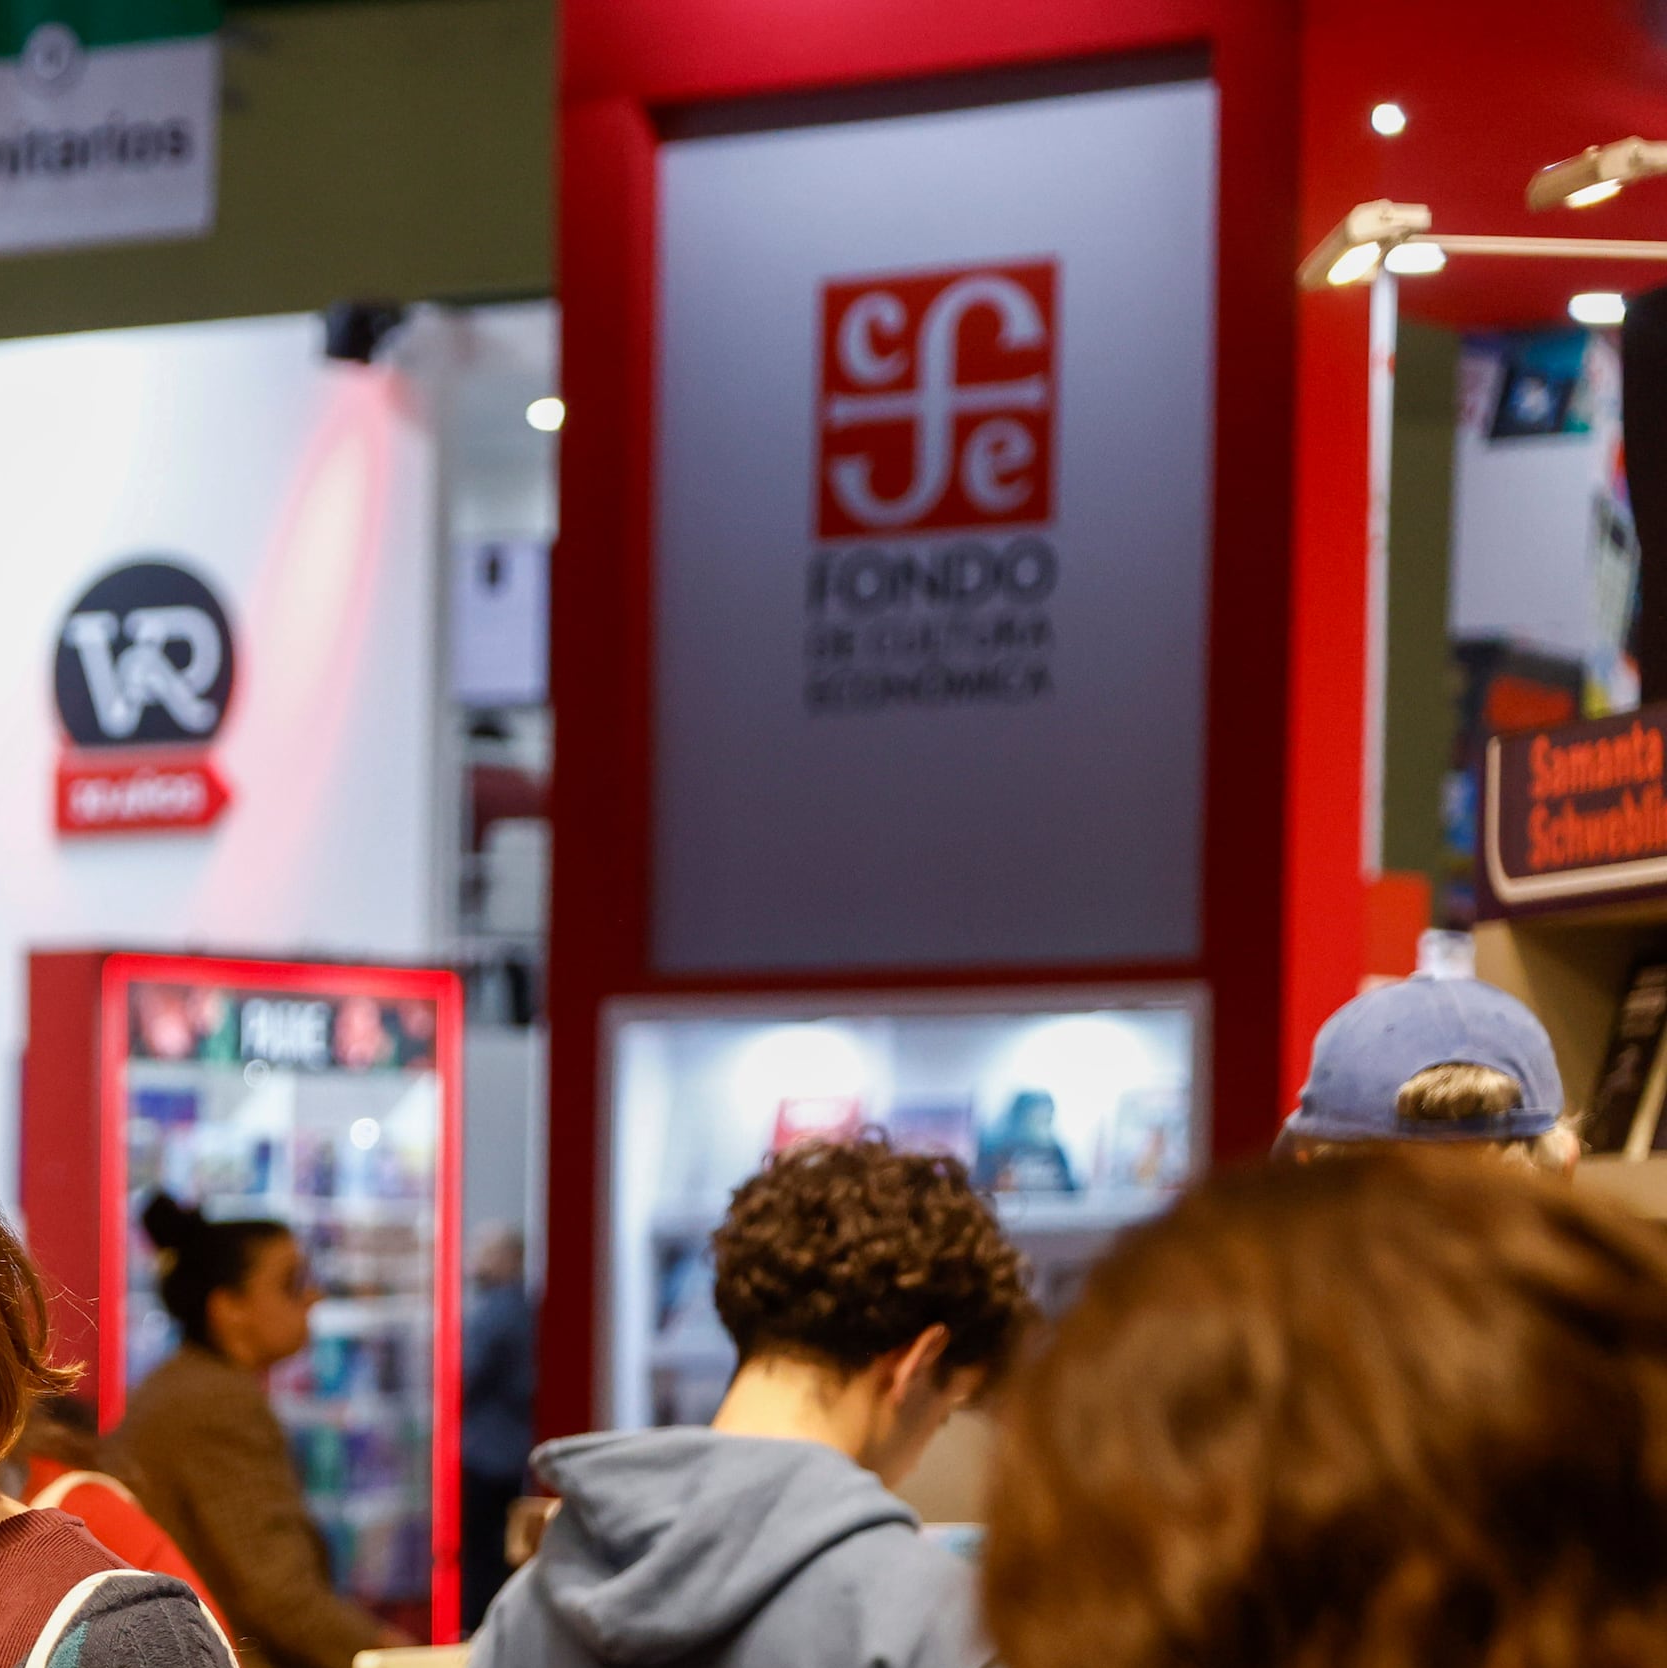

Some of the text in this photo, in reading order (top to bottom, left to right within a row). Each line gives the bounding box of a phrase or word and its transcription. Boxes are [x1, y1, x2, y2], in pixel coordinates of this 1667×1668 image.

[810, 536, 1058, 610] FONDO
[873, 614, 1052, 655] CULTURA
[1530, 720, 1664, 799] Samanta
